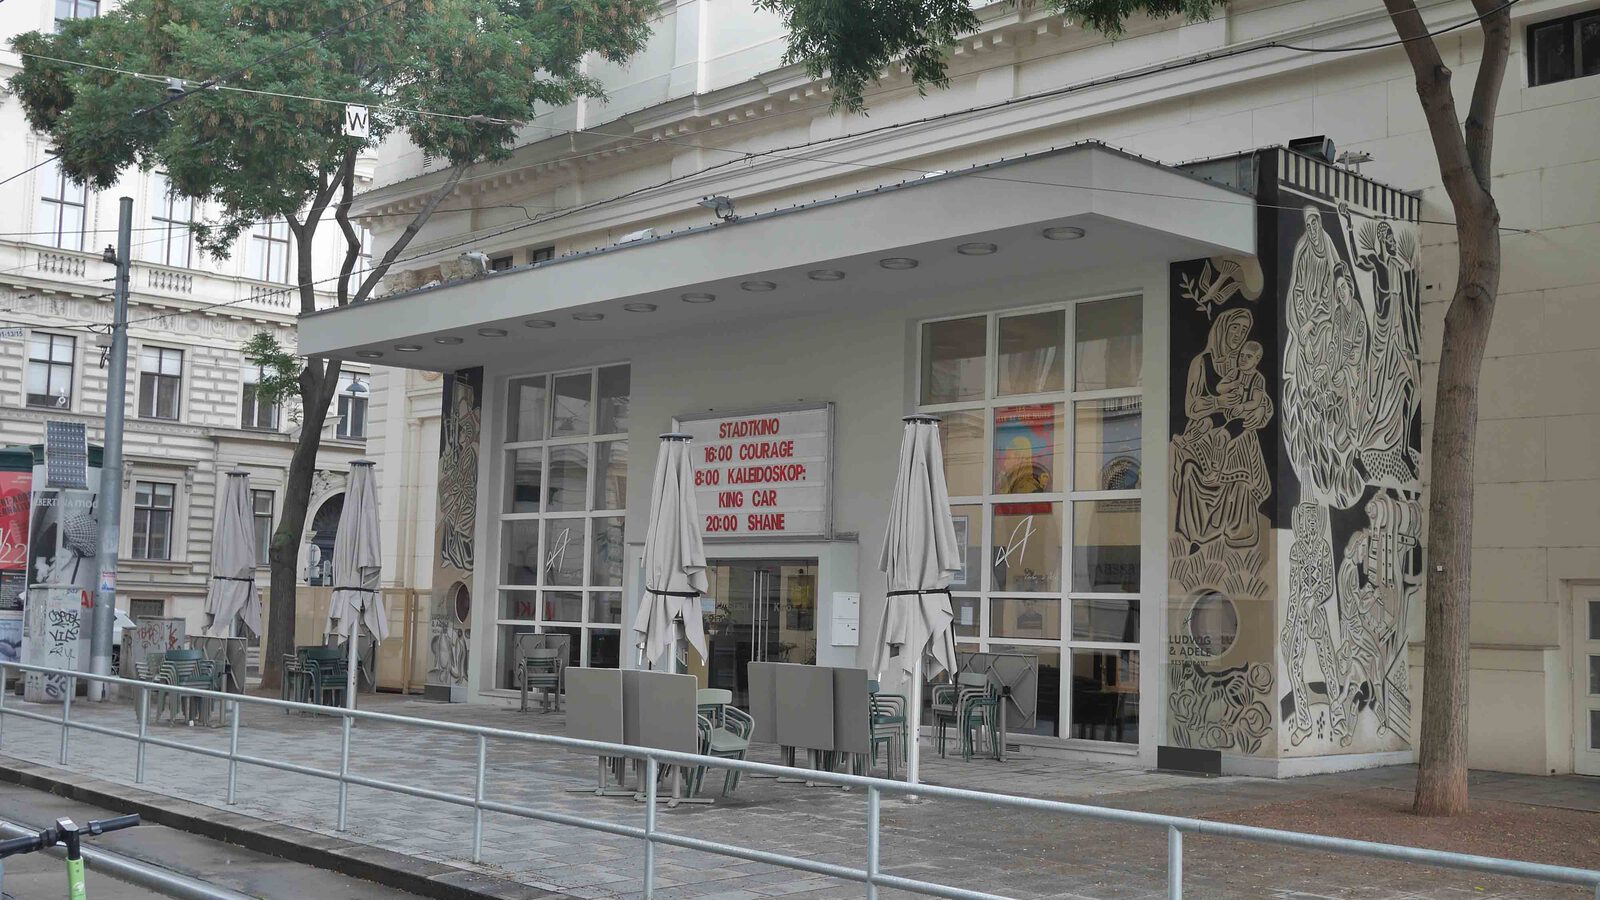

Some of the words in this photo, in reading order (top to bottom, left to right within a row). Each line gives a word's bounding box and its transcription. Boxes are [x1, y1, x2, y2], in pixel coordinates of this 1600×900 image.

[348, 111, 367, 131] W
[719, 418, 780, 438] STADTKINO
[705, 445, 732, 463] 16:00
[739, 441, 794, 460] COURAGE
[695, 470, 720, 486] 8:00
[719, 492, 744, 508] KING
[752, 490, 777, 506] CAR
[706, 515, 738, 532] 20:00
[748, 513, 784, 530] SHANE
[1169, 634, 1211, 645] LUDWIG
[1169, 646, 1176, 656] &
[1180, 646, 1211, 657] ADELE
